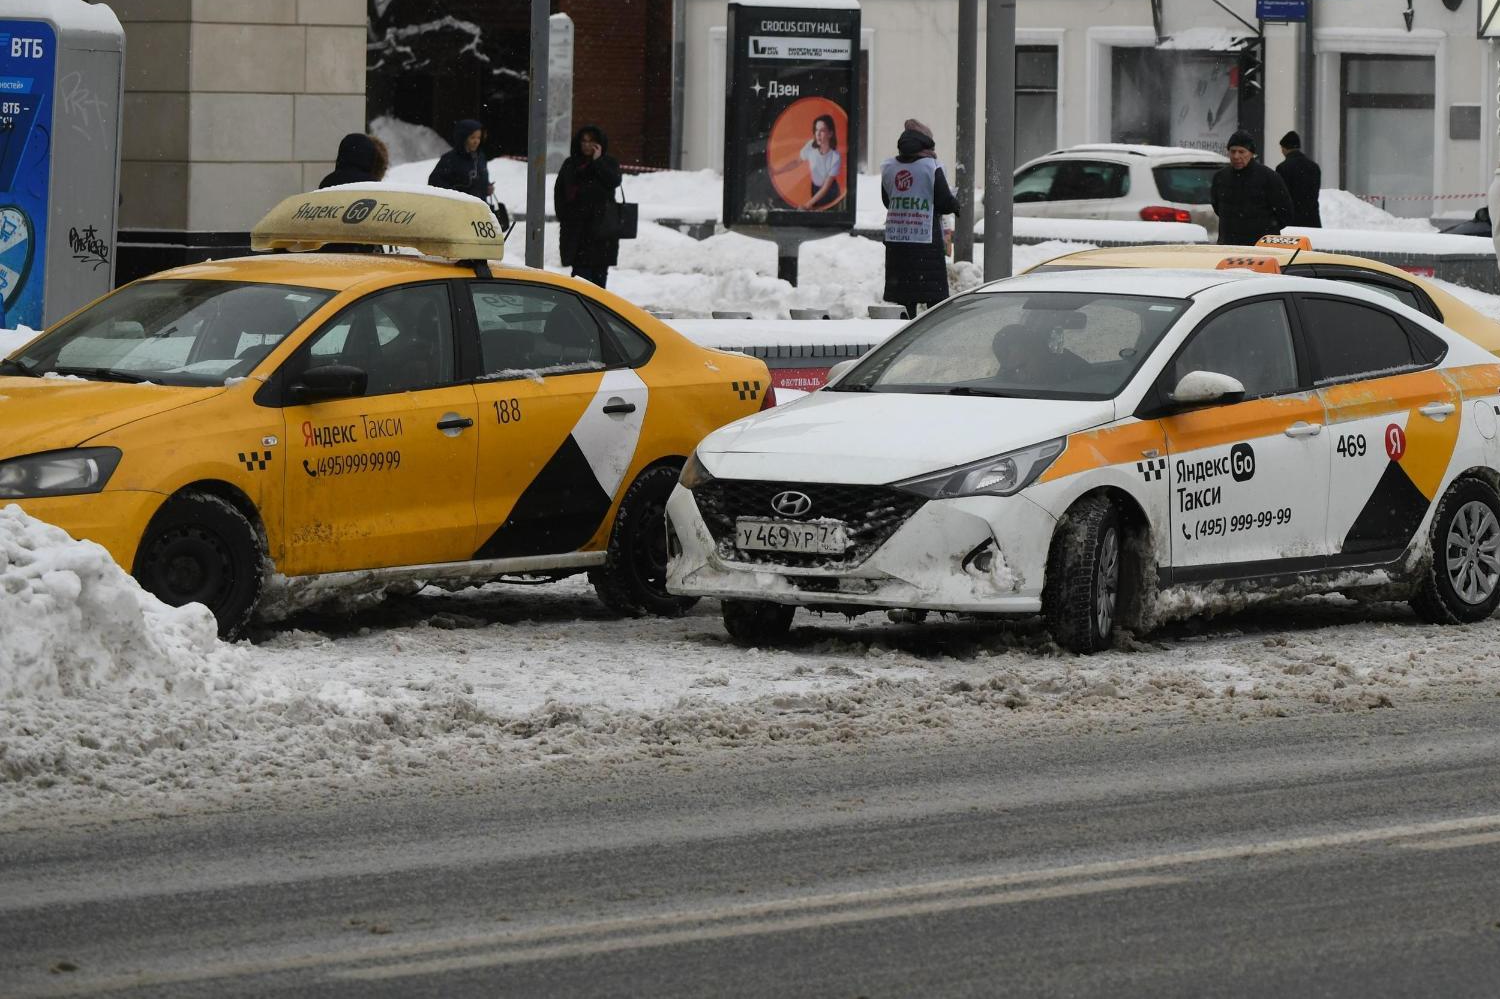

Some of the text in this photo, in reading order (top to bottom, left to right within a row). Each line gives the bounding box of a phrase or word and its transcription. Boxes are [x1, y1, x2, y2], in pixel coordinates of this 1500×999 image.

[761, 20, 840, 33] CROCUS CITY HALL
[11, 38, 43, 59] ВТБ
[768, 81, 800, 98] Дзен
[2, 103, 20, 114] ВТБ
[292, 201, 496, 238] Яндекс Go Такси 188
[781, 378, 820, 387] ФЕСТИВАЛЬ
[492, 398, 521, 424] 188
[302, 414, 403, 448] Яндекс Такси
[1337, 435, 1366, 458] 469
[1176, 451, 1253, 484] Яндекс Go
[1177, 486, 1221, 512] Такси
[1195, 507, 1292, 540] (495) 999-99-99
